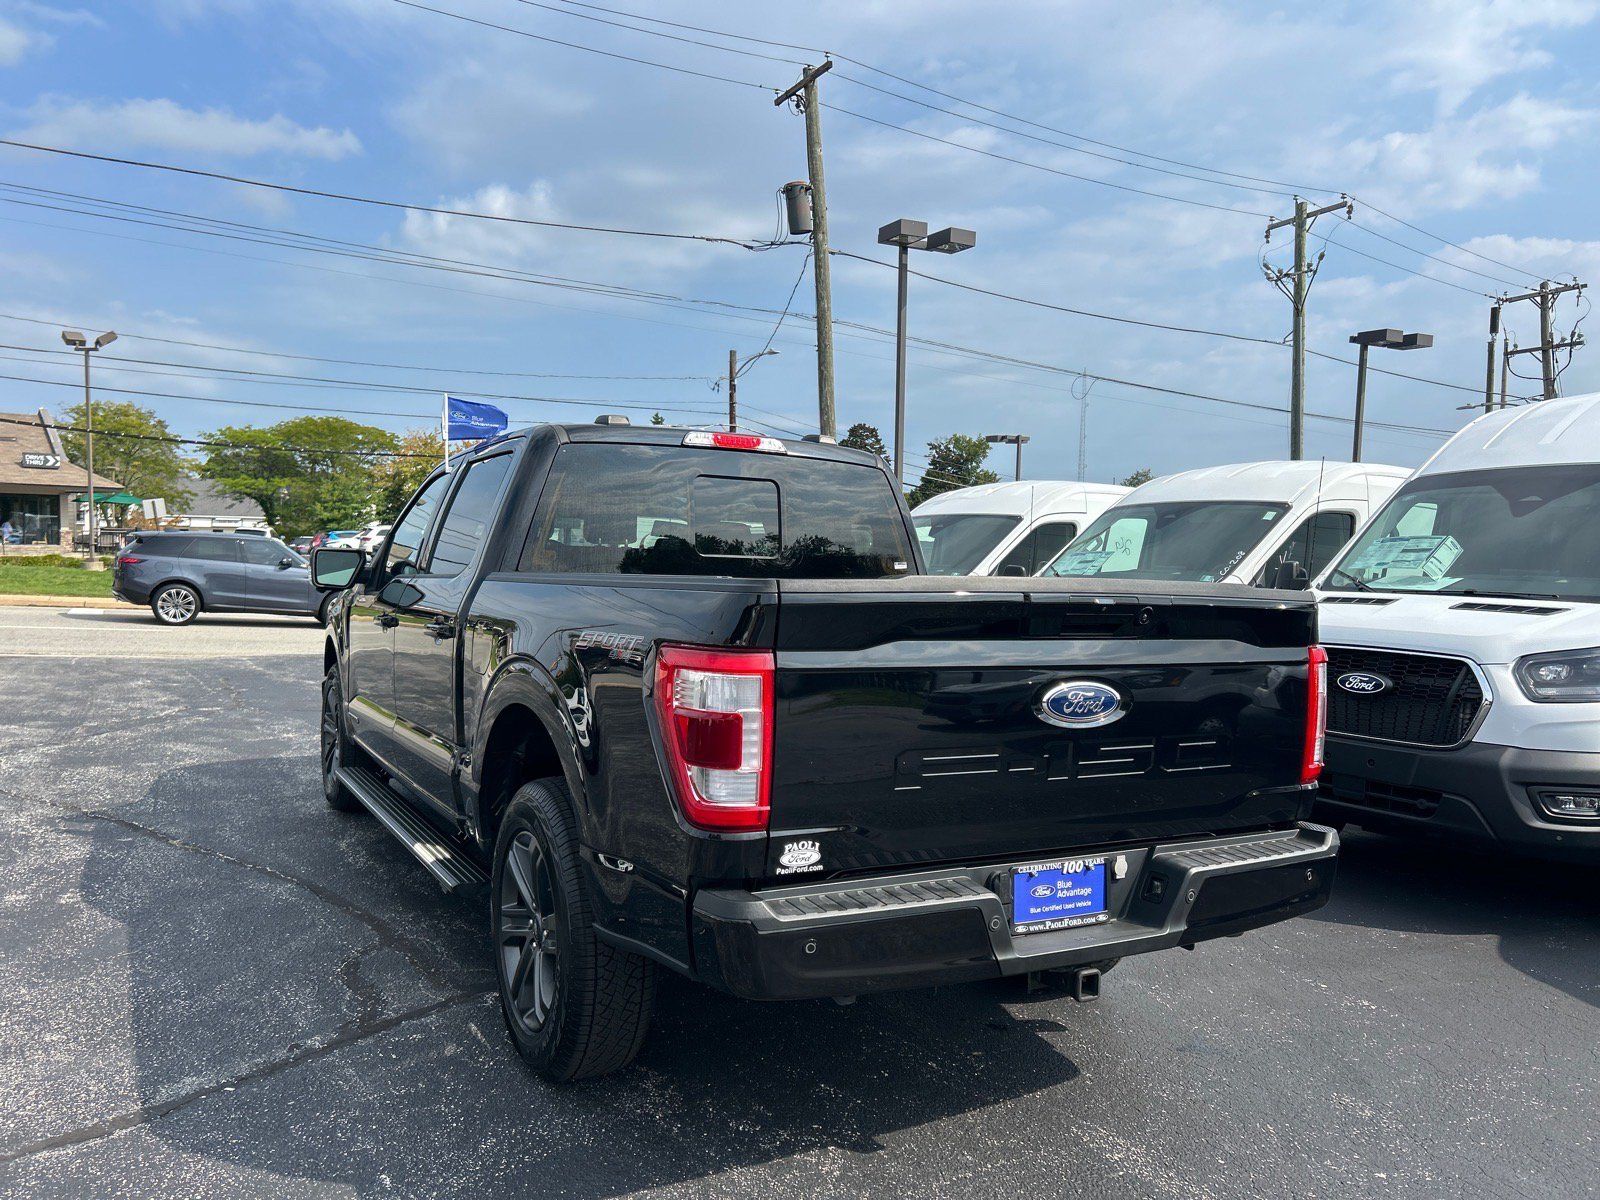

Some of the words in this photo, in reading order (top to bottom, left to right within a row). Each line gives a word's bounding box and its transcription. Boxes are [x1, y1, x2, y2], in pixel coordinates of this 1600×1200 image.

[575, 631, 645, 650] SPORT
[1345, 675, 1376, 691] Ford
[1063, 690, 1105, 714] Ford
[783, 840, 820, 854] PAOLI
[788, 854, 813, 864] Ford
[776, 864, 824, 875] PaoliFord.com
[1017, 862, 1062, 874] CELEBRATING
[1062, 860, 1084, 875] 100
[1085, 858, 1104, 867] YEARS
[1035, 886, 1051, 896] Ford
[1057, 881, 1072, 889] Blue
[1057, 888, 1092, 898] Advantage
[1042, 904, 1063, 912] Certified
[1063, 902, 1075, 910] Used
[1075, 900, 1092, 908] Vehicle
